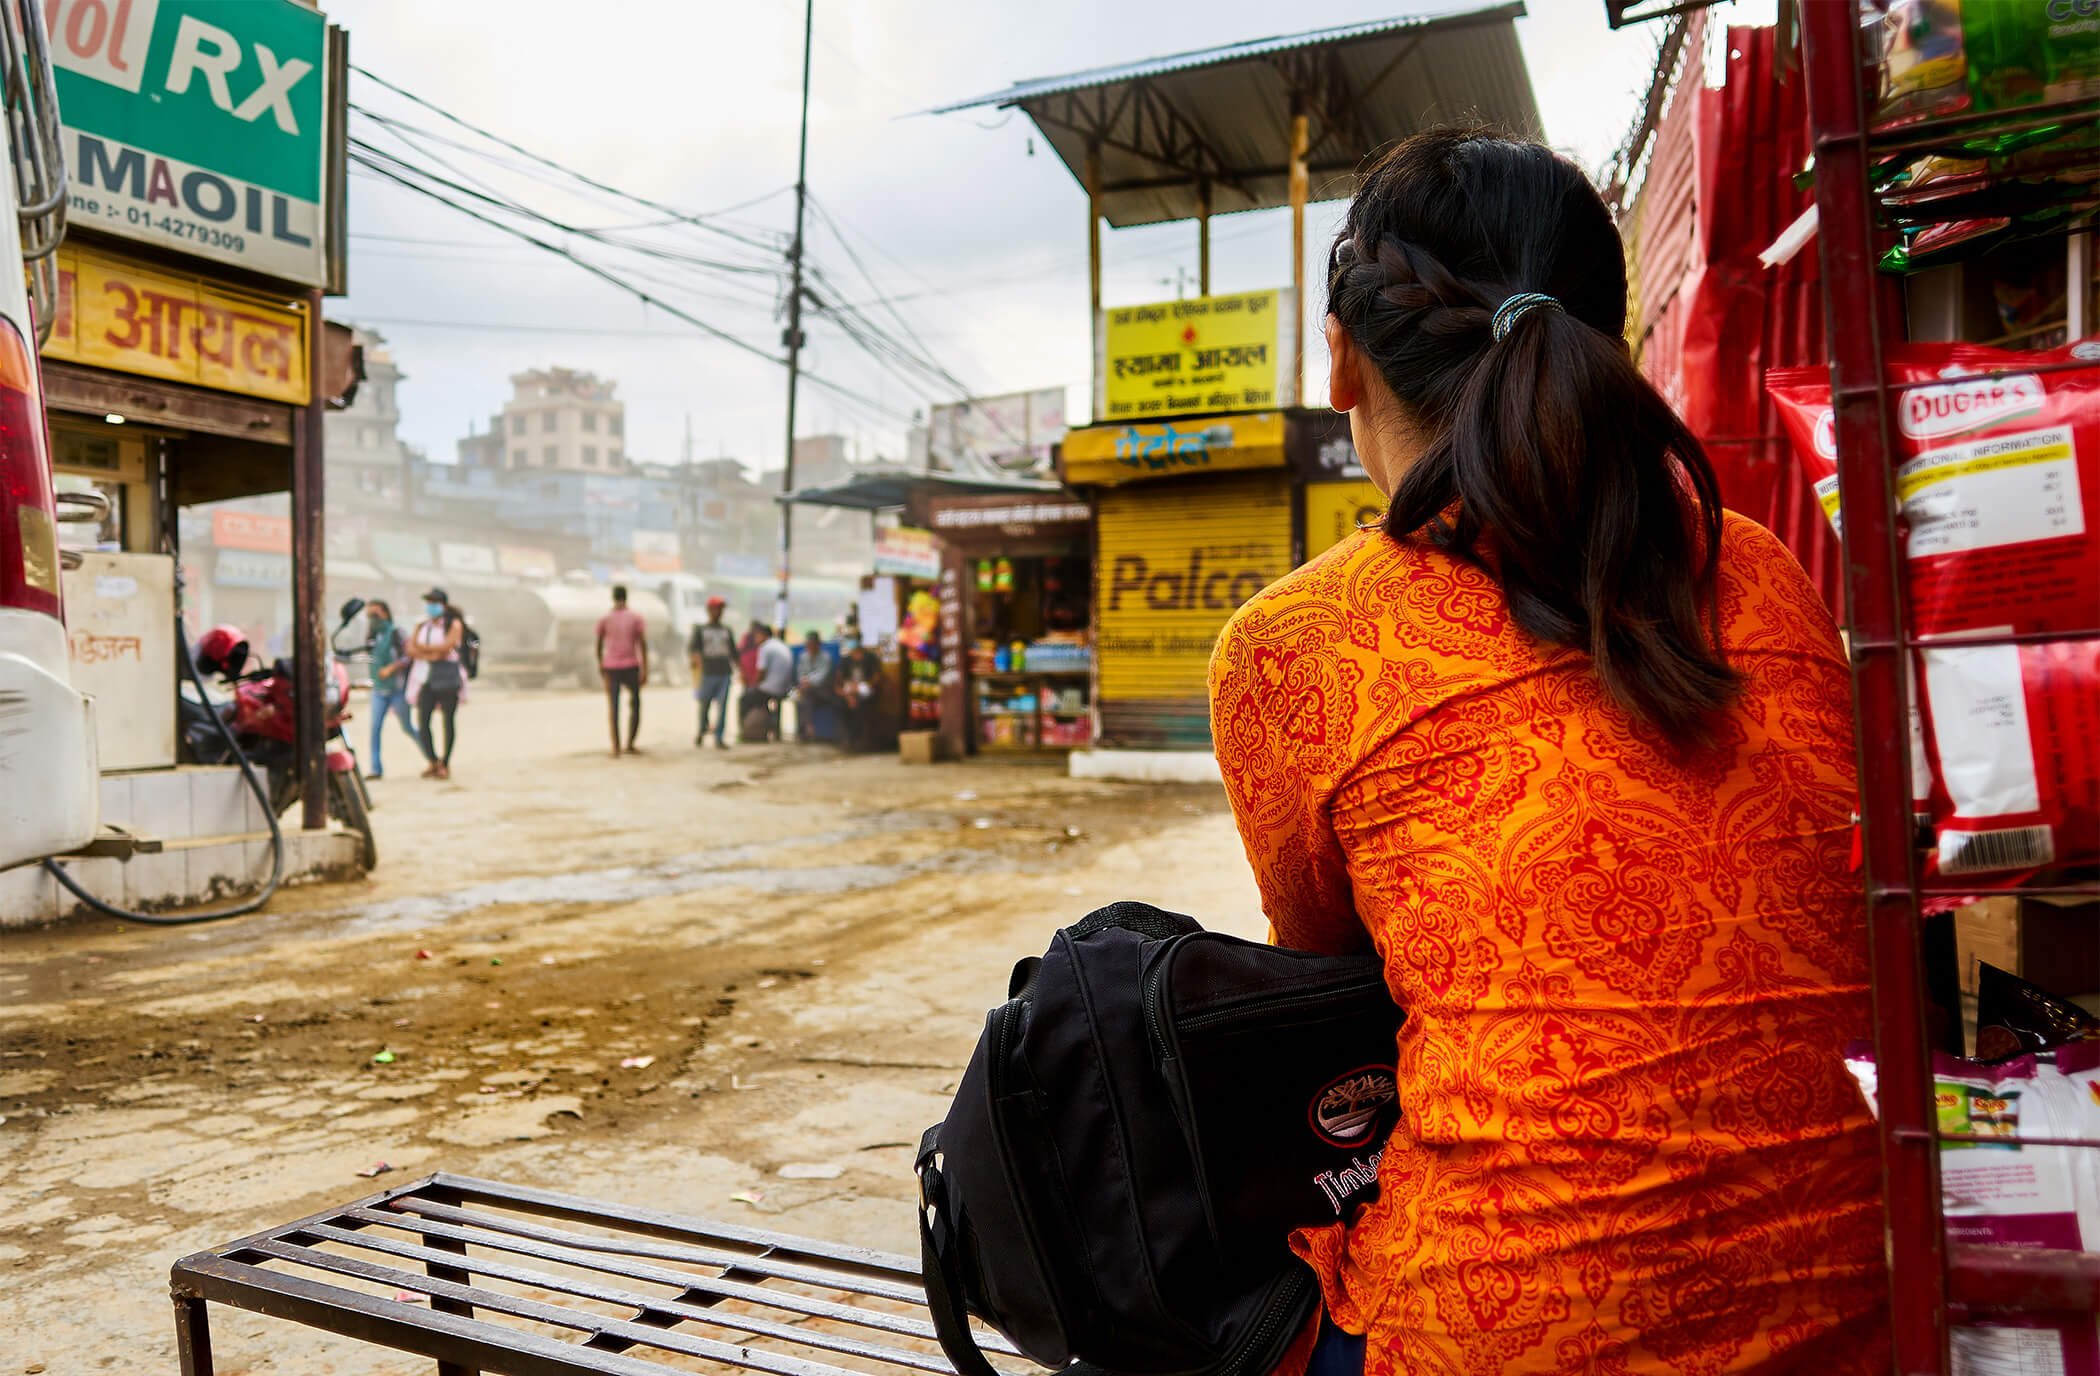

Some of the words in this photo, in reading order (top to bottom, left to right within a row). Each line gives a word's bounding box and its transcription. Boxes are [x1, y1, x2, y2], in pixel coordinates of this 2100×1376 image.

[165, 14, 314, 136] RX
[77, 133, 312, 248] MAOIL
[127, 206, 245, 252] 01-4279309
[103, 279, 298, 383] आयल
[1109, 548, 1264, 610] Palco
